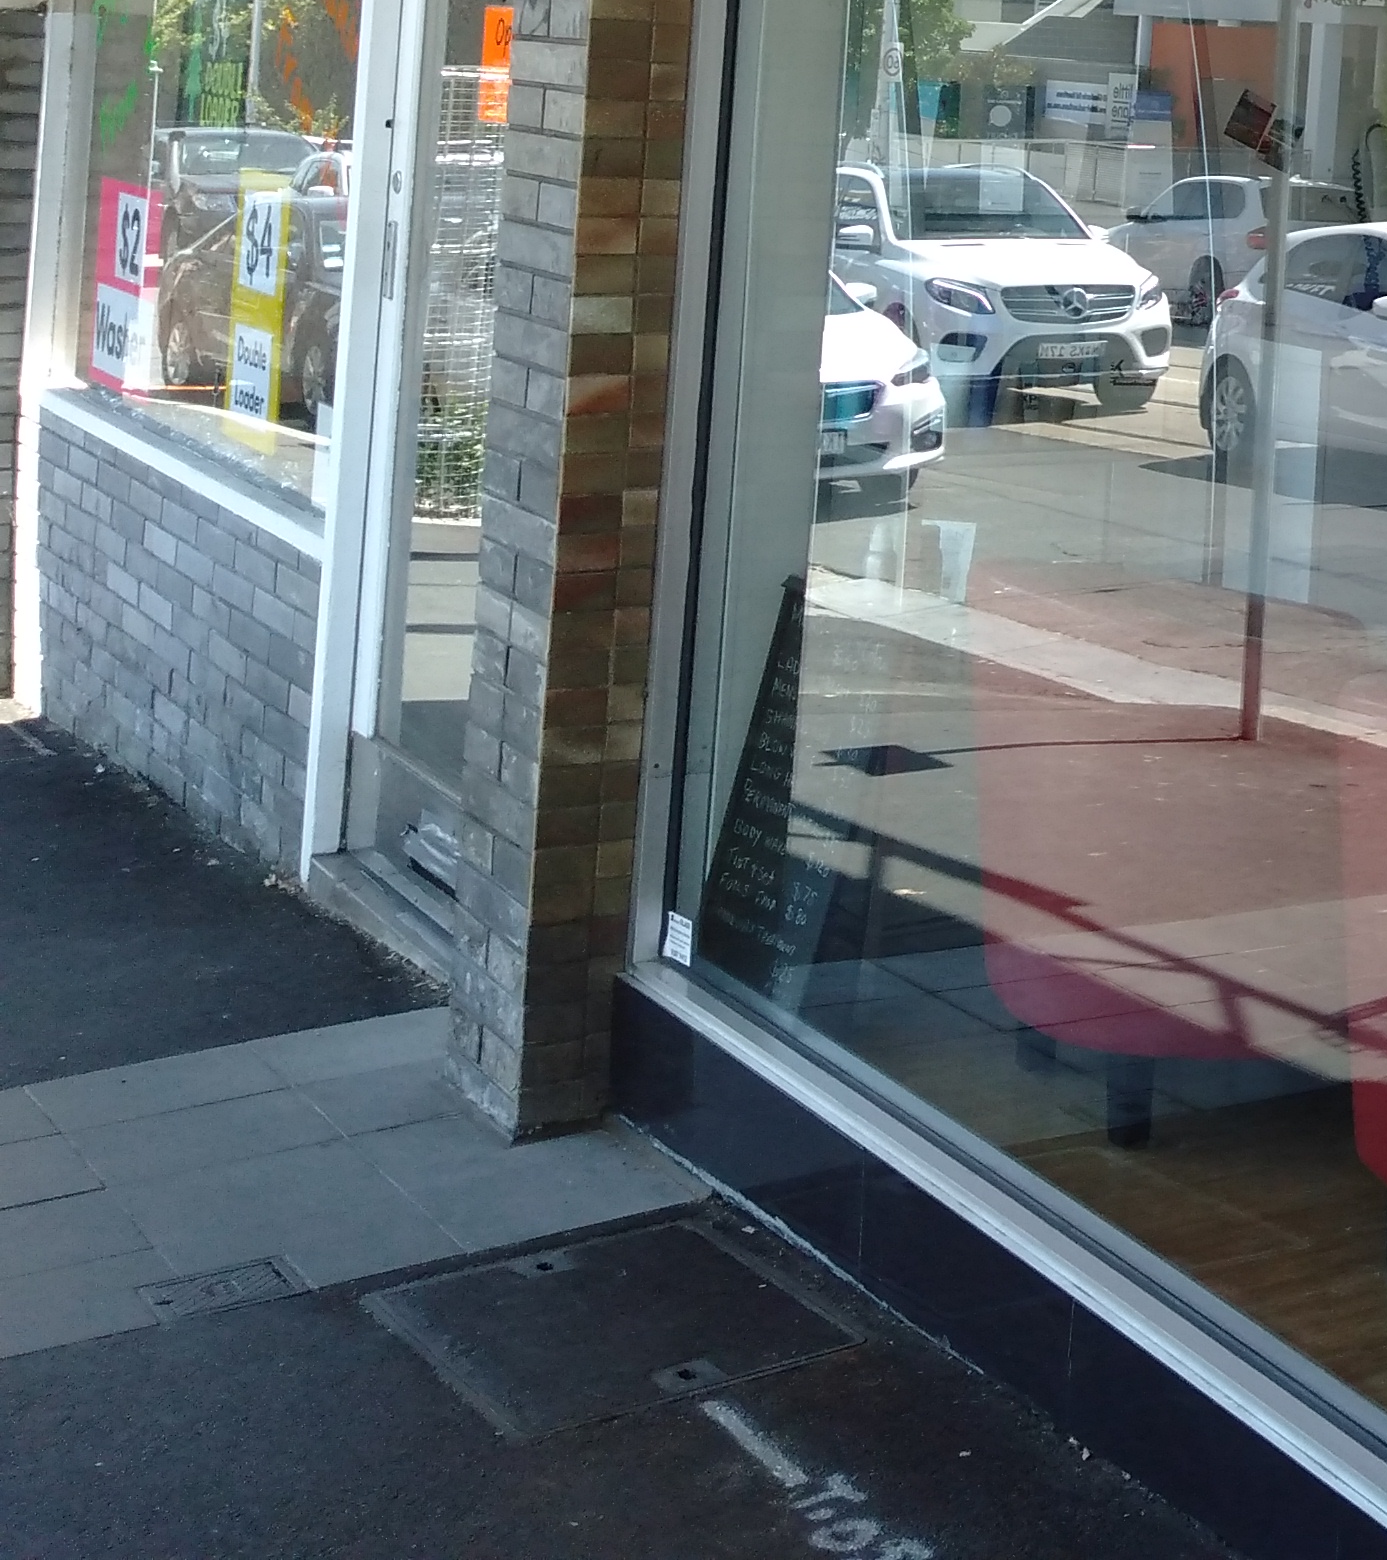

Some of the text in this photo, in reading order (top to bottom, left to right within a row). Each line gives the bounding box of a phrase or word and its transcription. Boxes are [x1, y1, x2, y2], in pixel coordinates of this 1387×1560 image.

[118, 202, 142, 275] $2
[245, 201, 275, 287] $4
[236, 334, 268, 372] Double
[232, 388, 266, 417] Loader
